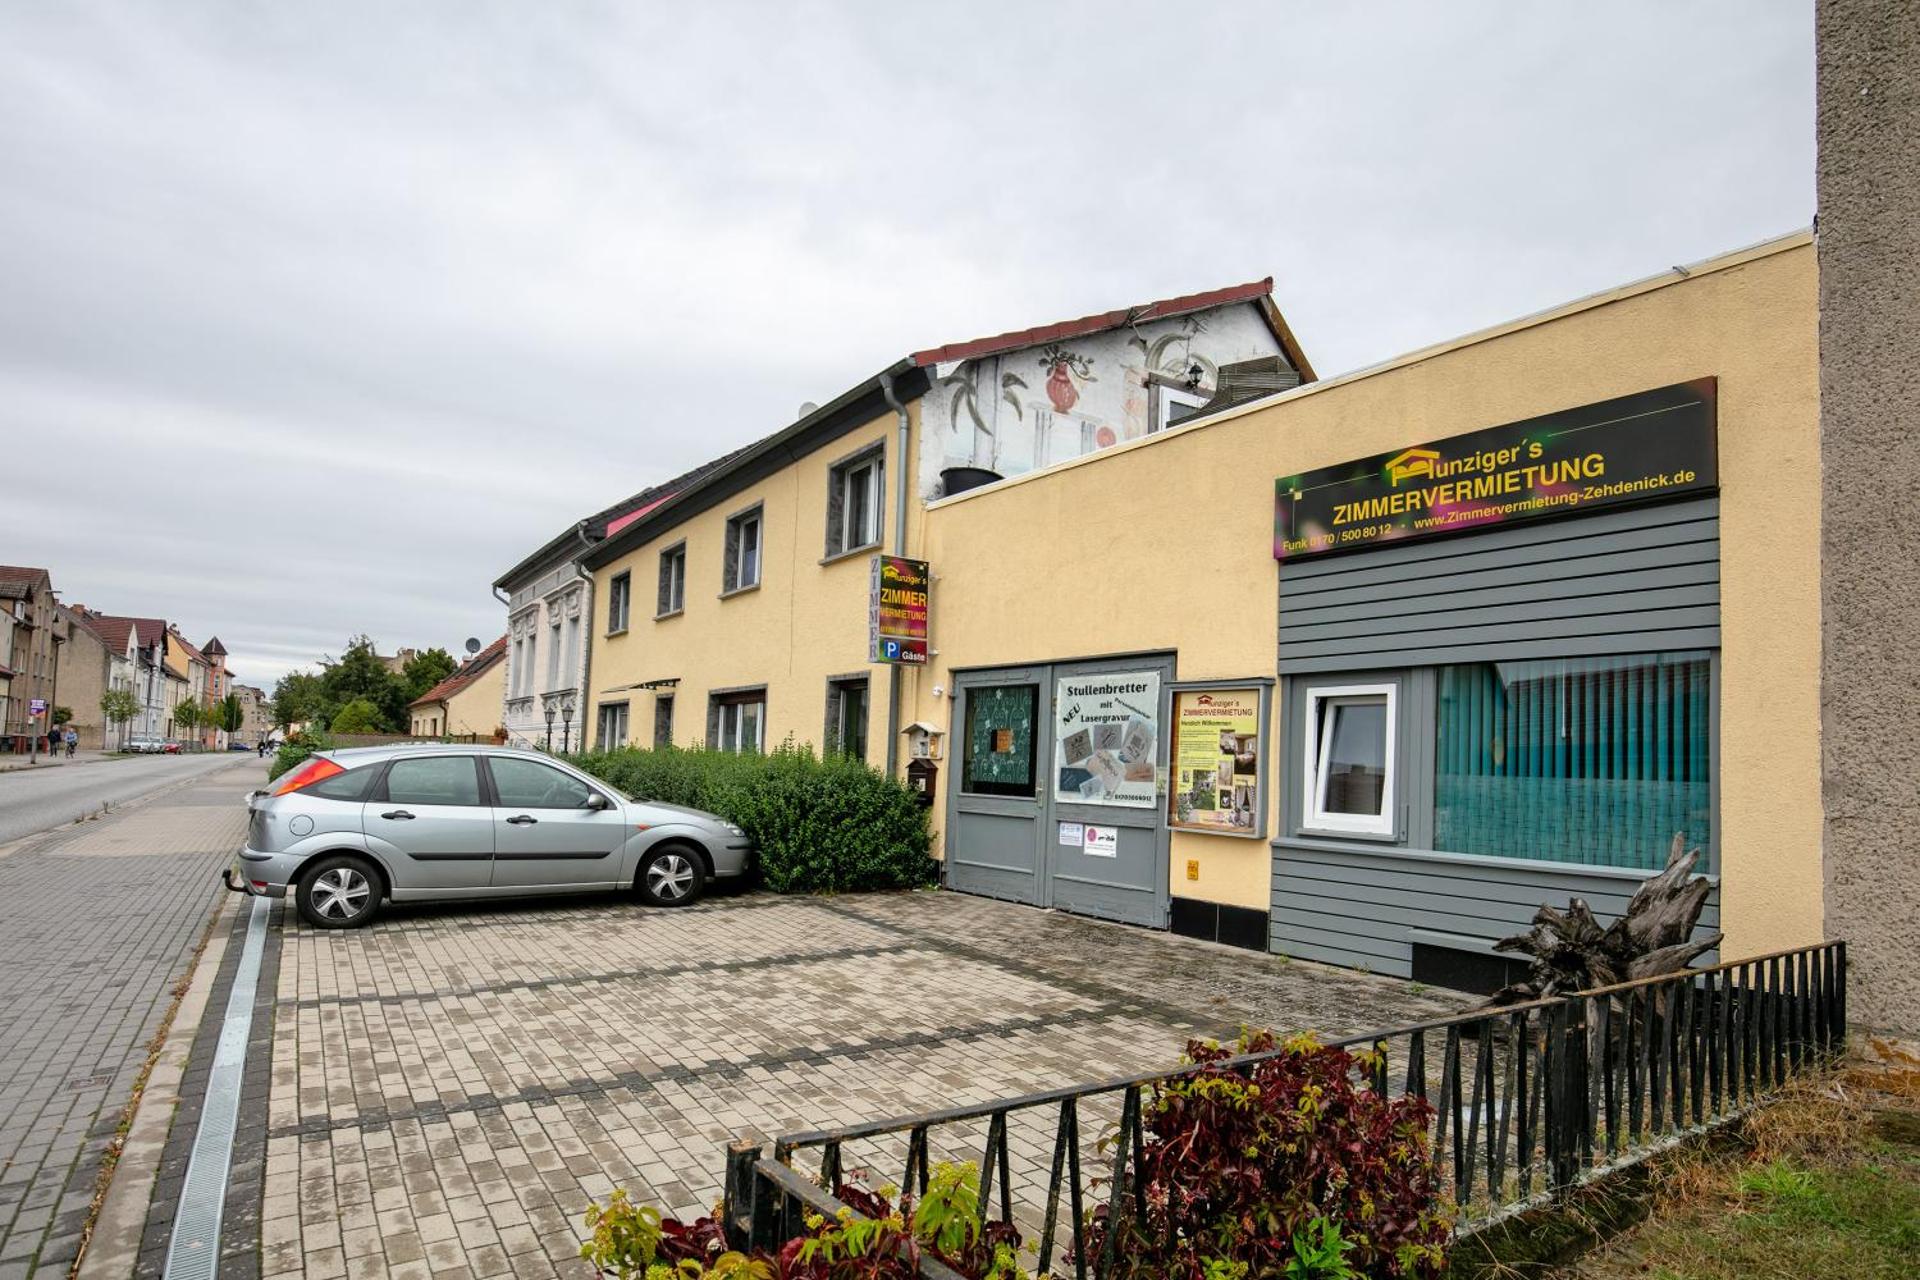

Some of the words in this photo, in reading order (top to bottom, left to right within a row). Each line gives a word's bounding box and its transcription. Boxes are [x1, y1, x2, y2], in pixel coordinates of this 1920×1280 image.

[1333, 453, 1605, 525] ZIMMERVERMIETUNG
[1283, 538, 1307, 552] Funk
[1310, 533, 1335, 547] 0170
[1342, 527, 1362, 542] 500
[1363, 525, 1377, 538] 80
[1379, 523, 1392, 535] 12
[1414, 469, 1696, 530] www.Zimmervermietung-Zehdenick.de
[881, 588, 927, 607] ZIMMER
[880, 607, 927, 621] VERMIETUNG
[887, 641, 897, 658] P
[902, 650, 926, 662] Gäste
[1067, 683, 1148, 697] Stullenbretter
[1100, 700, 1113, 709] mit
[1183, 708, 1253, 717] ZIMMERVERMIETUNG
[1062, 702, 1082, 726] NEU
[1081, 714, 1131, 724] Lasergravur
